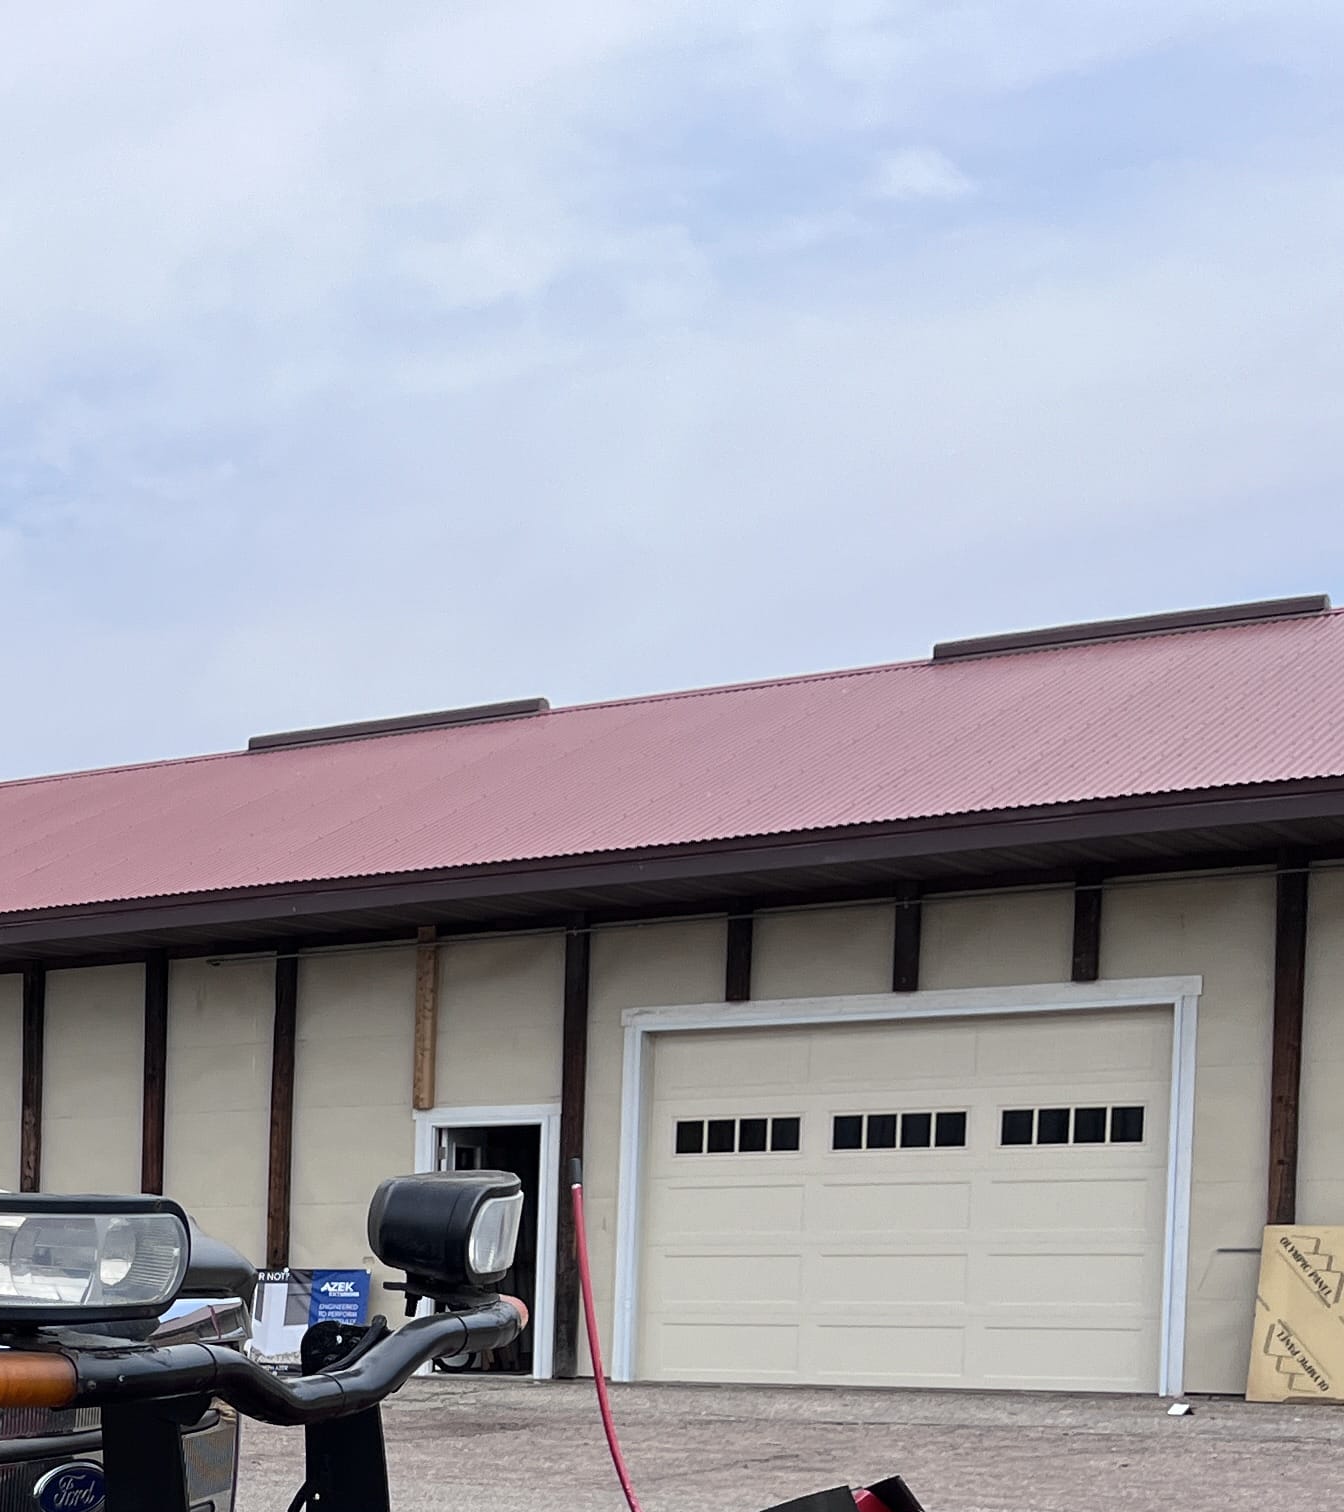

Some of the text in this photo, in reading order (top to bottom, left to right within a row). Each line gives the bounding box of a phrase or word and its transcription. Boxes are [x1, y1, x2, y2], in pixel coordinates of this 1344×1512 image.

[1280, 1237, 1332, 1296] OLYMPIC PANEL
[320, 1281, 355, 1292] AZEK
[54, 1474, 96, 1507] Ford
